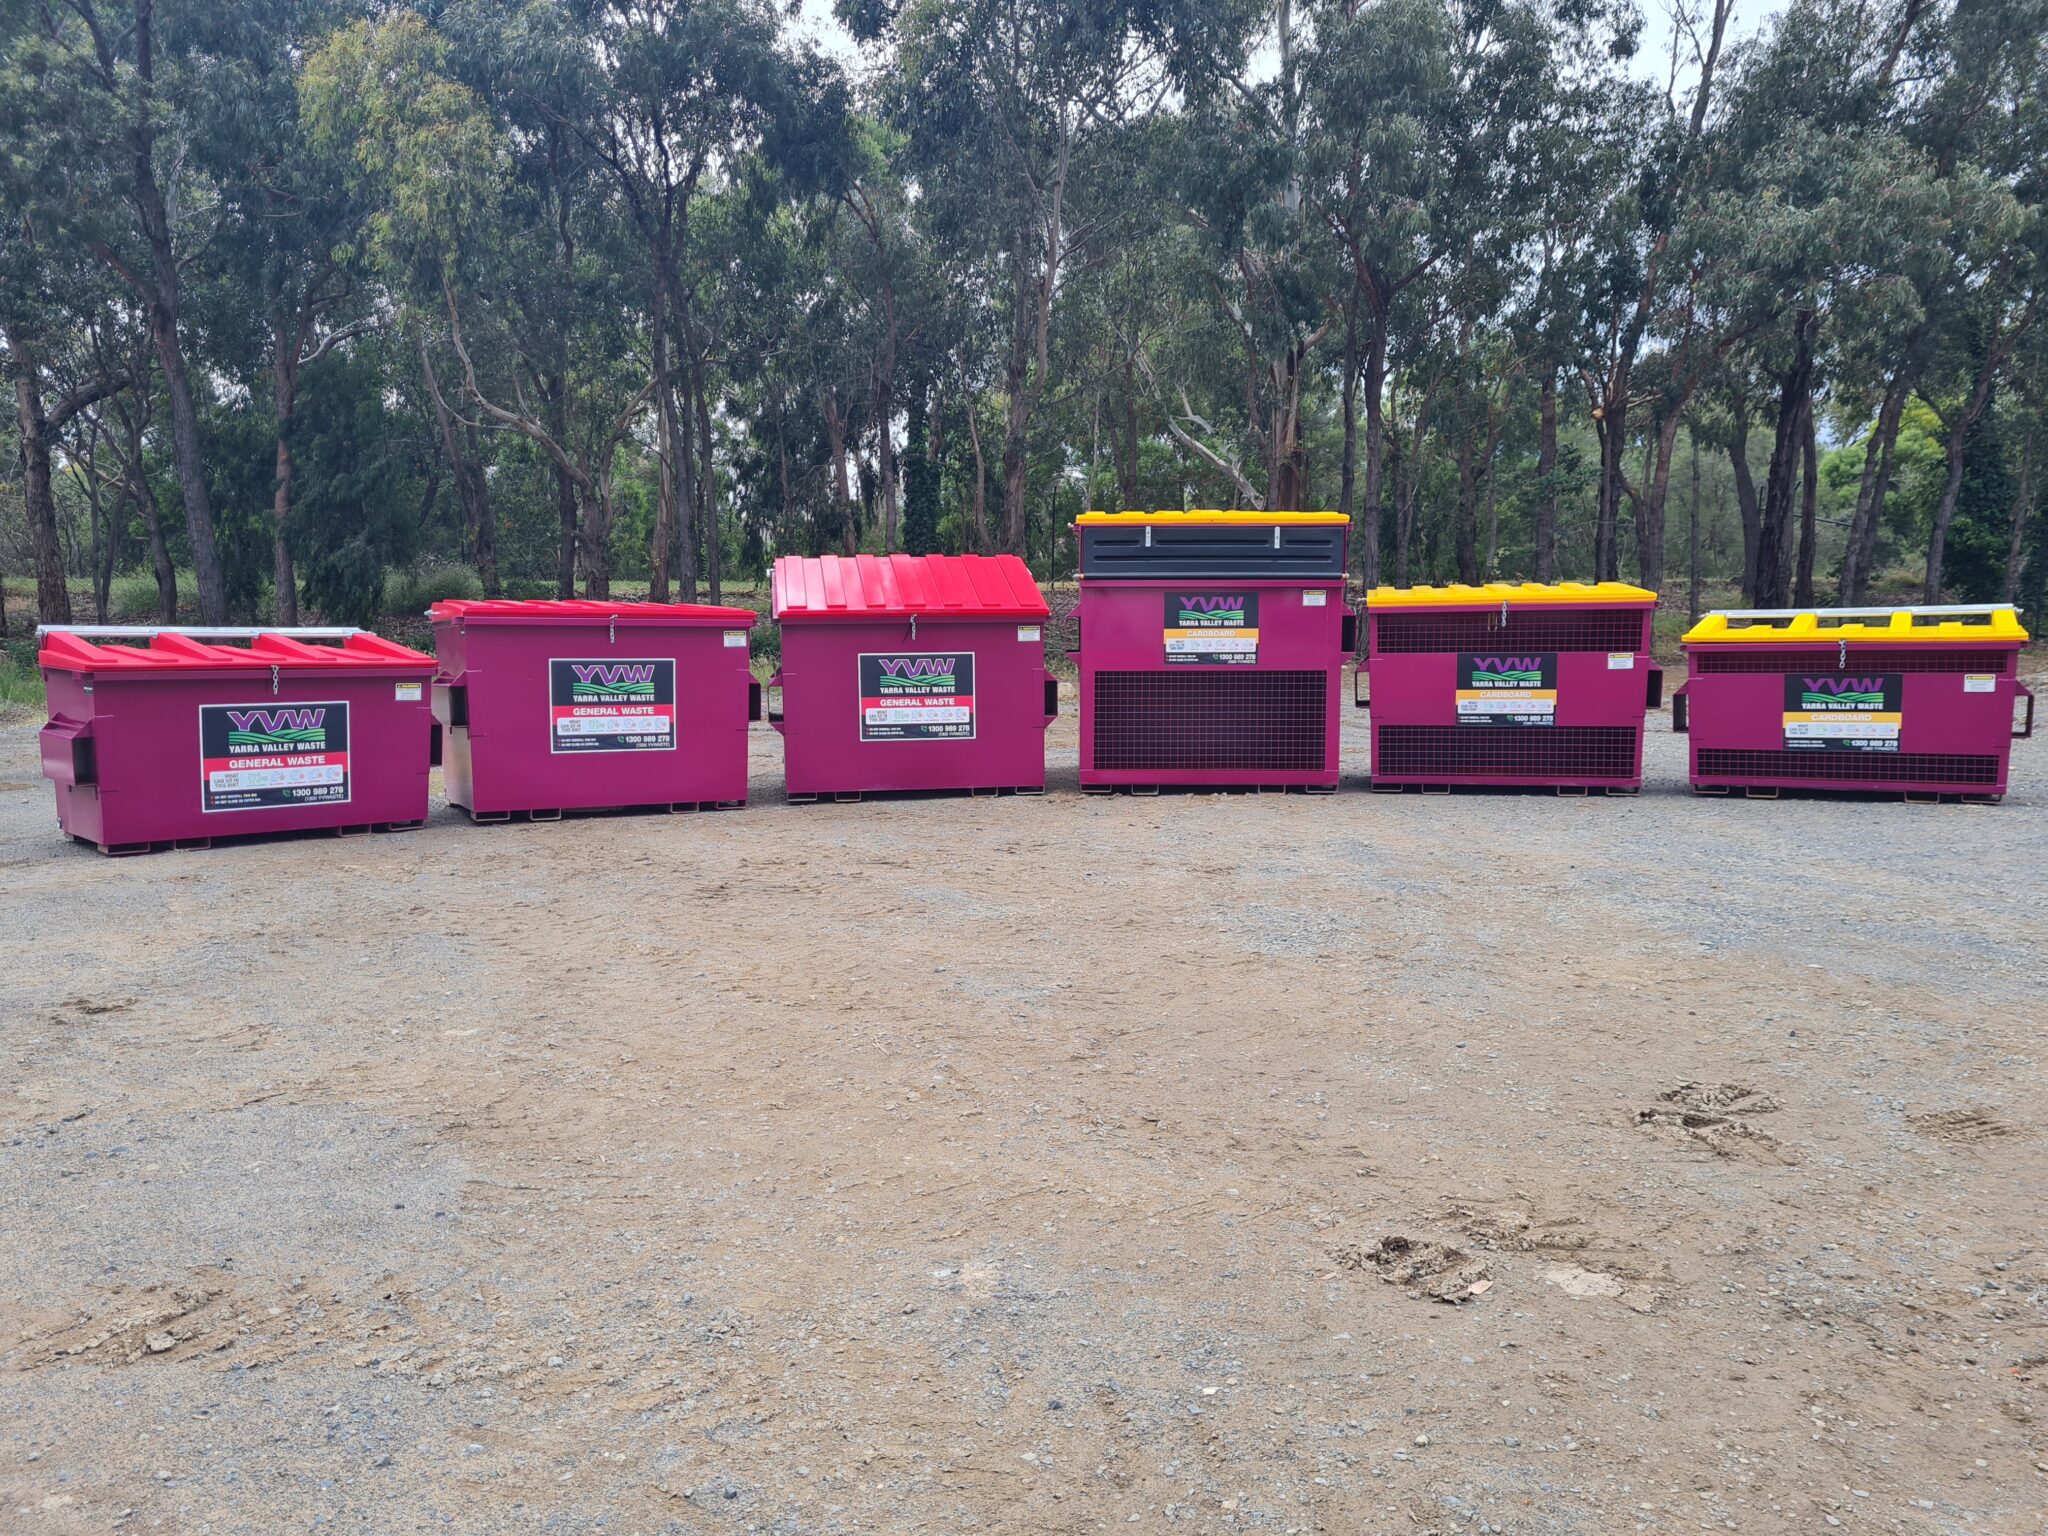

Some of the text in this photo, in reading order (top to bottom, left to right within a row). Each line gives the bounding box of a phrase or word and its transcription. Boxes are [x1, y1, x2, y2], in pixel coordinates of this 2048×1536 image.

[1180, 596, 1244, 612] YVW
[879, 658, 955, 678] YVW
[1473, 657, 1541, 672] YVW
[571, 665, 655, 685] YVW
[1803, 678, 1884, 694] YVW
[226, 708, 325, 733] YVW
[229, 742, 325, 753] YARRA VALLEY WASTE
[229, 756, 325, 768] GENERAL WASTE
